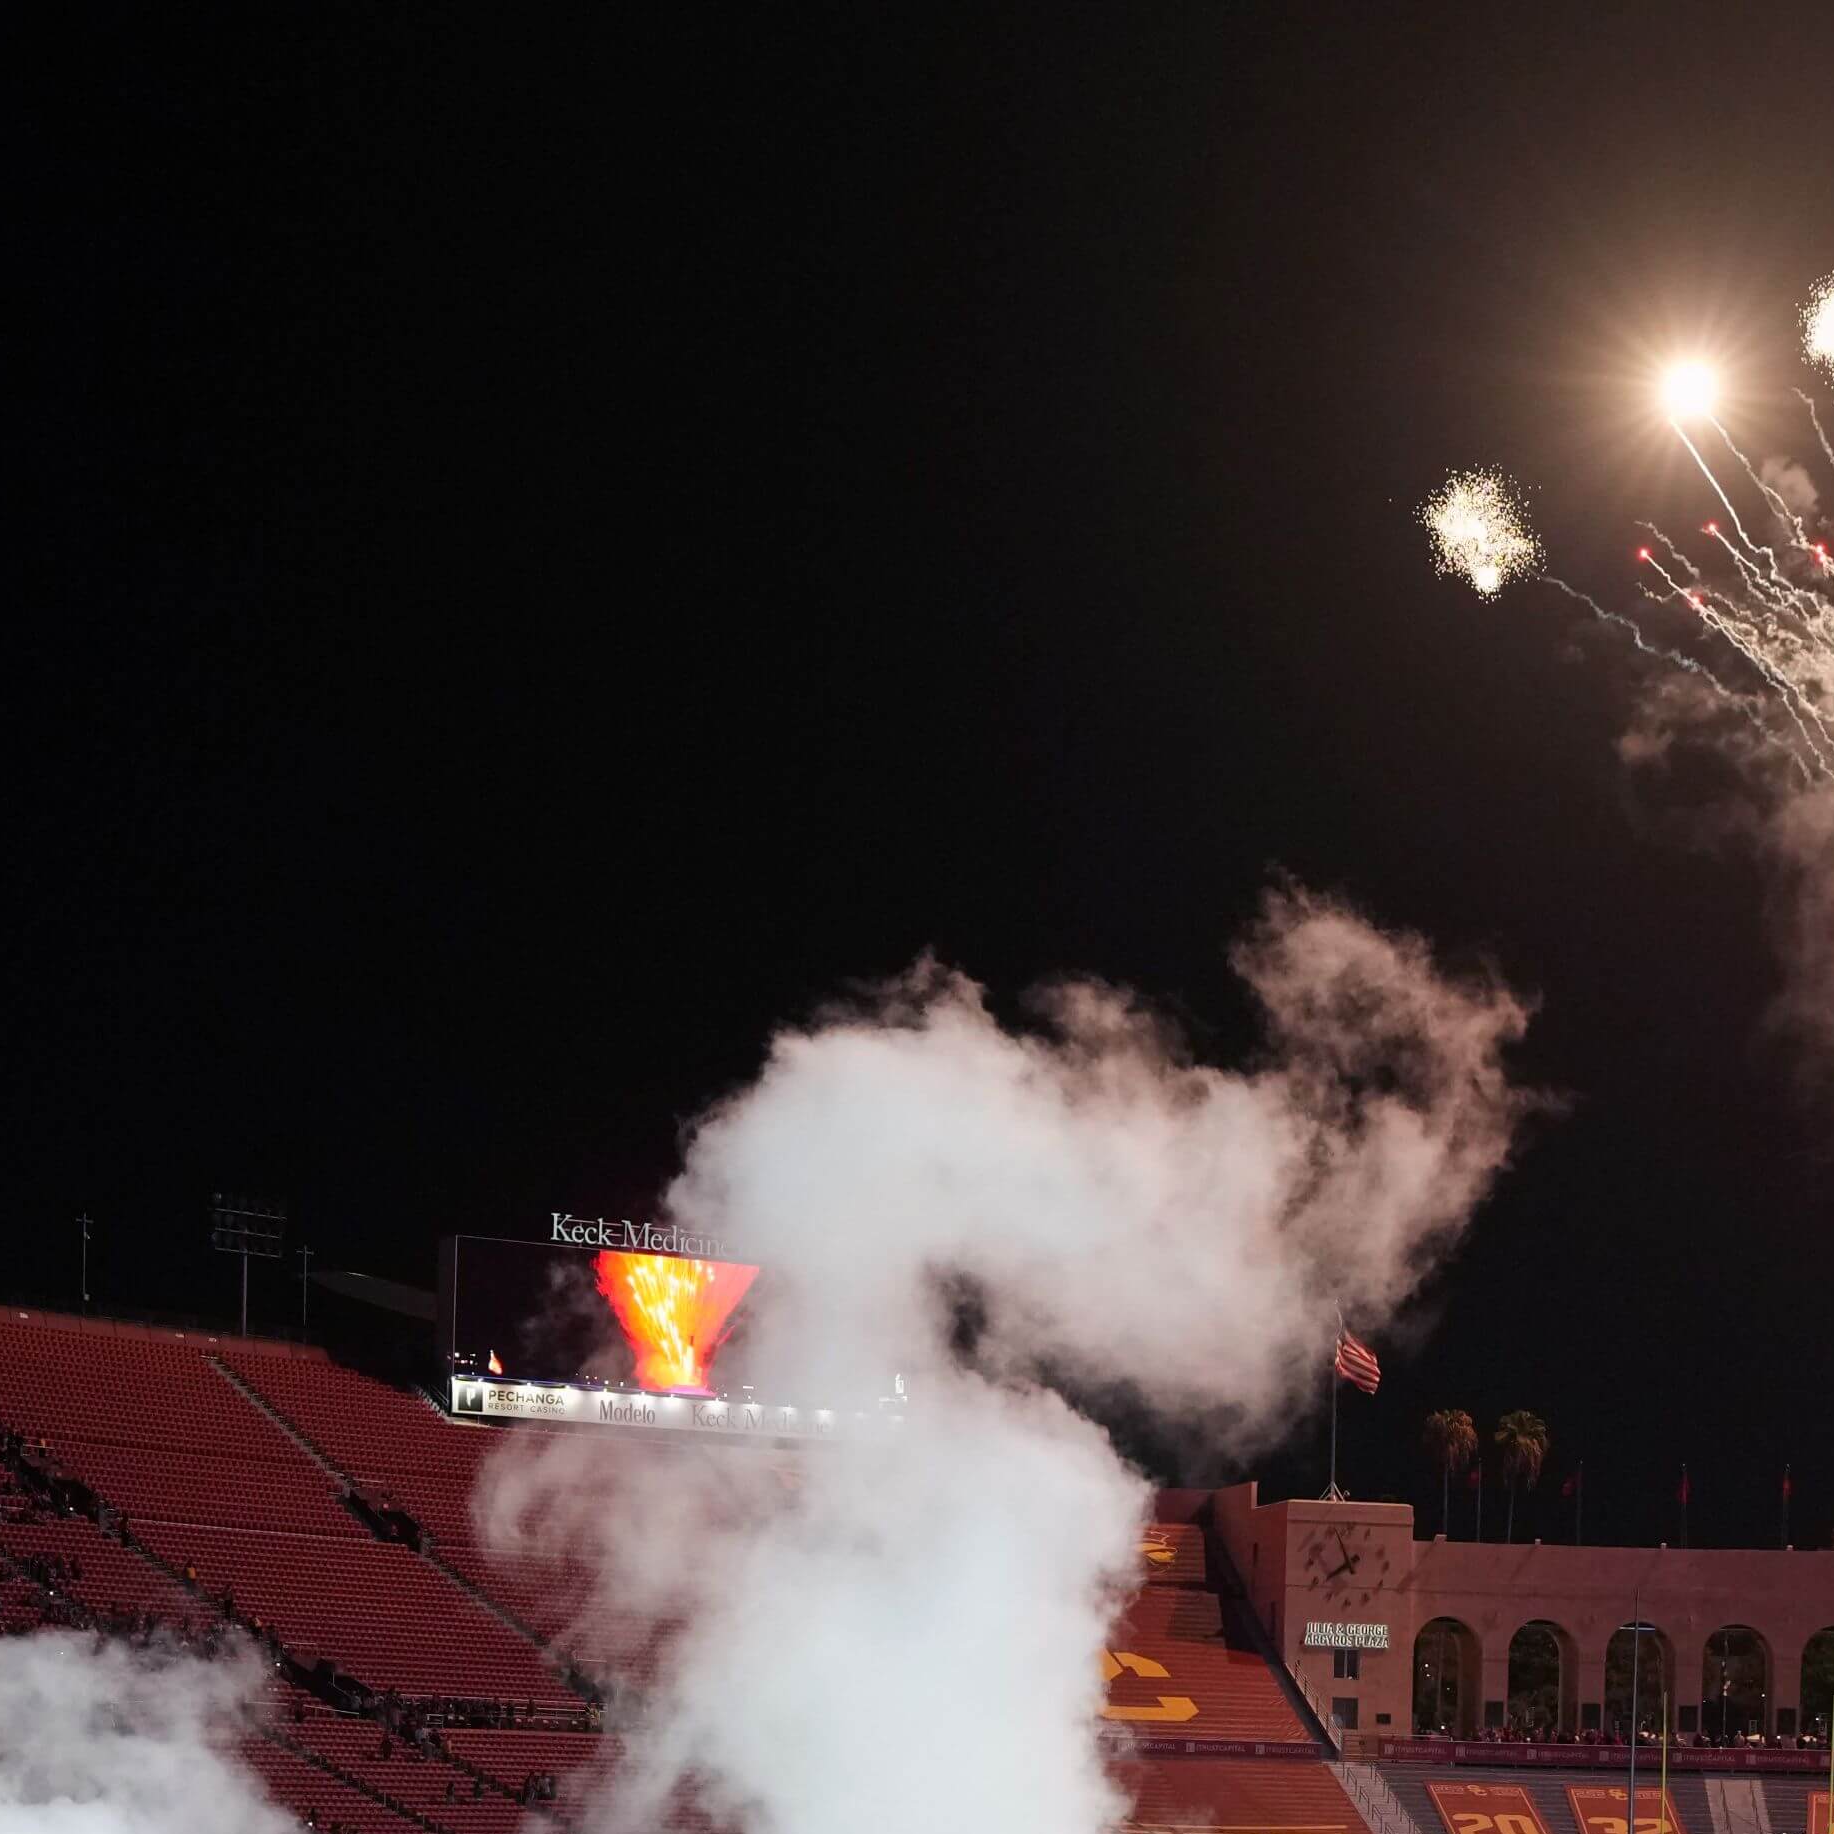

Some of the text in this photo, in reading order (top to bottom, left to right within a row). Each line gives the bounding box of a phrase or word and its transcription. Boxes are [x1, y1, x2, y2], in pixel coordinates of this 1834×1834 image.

[550, 1212, 615, 1246] Keck
[488, 1390, 565, 1407] PECHANGA
[488, 1403, 524, 1413] RESORT
[599, 1399, 656, 1425] Modelo
[692, 1407, 736, 1429] Keck
[1307, 1622, 1333, 1635] JULIA
[1355, 1636, 1389, 1648] PLAZA
